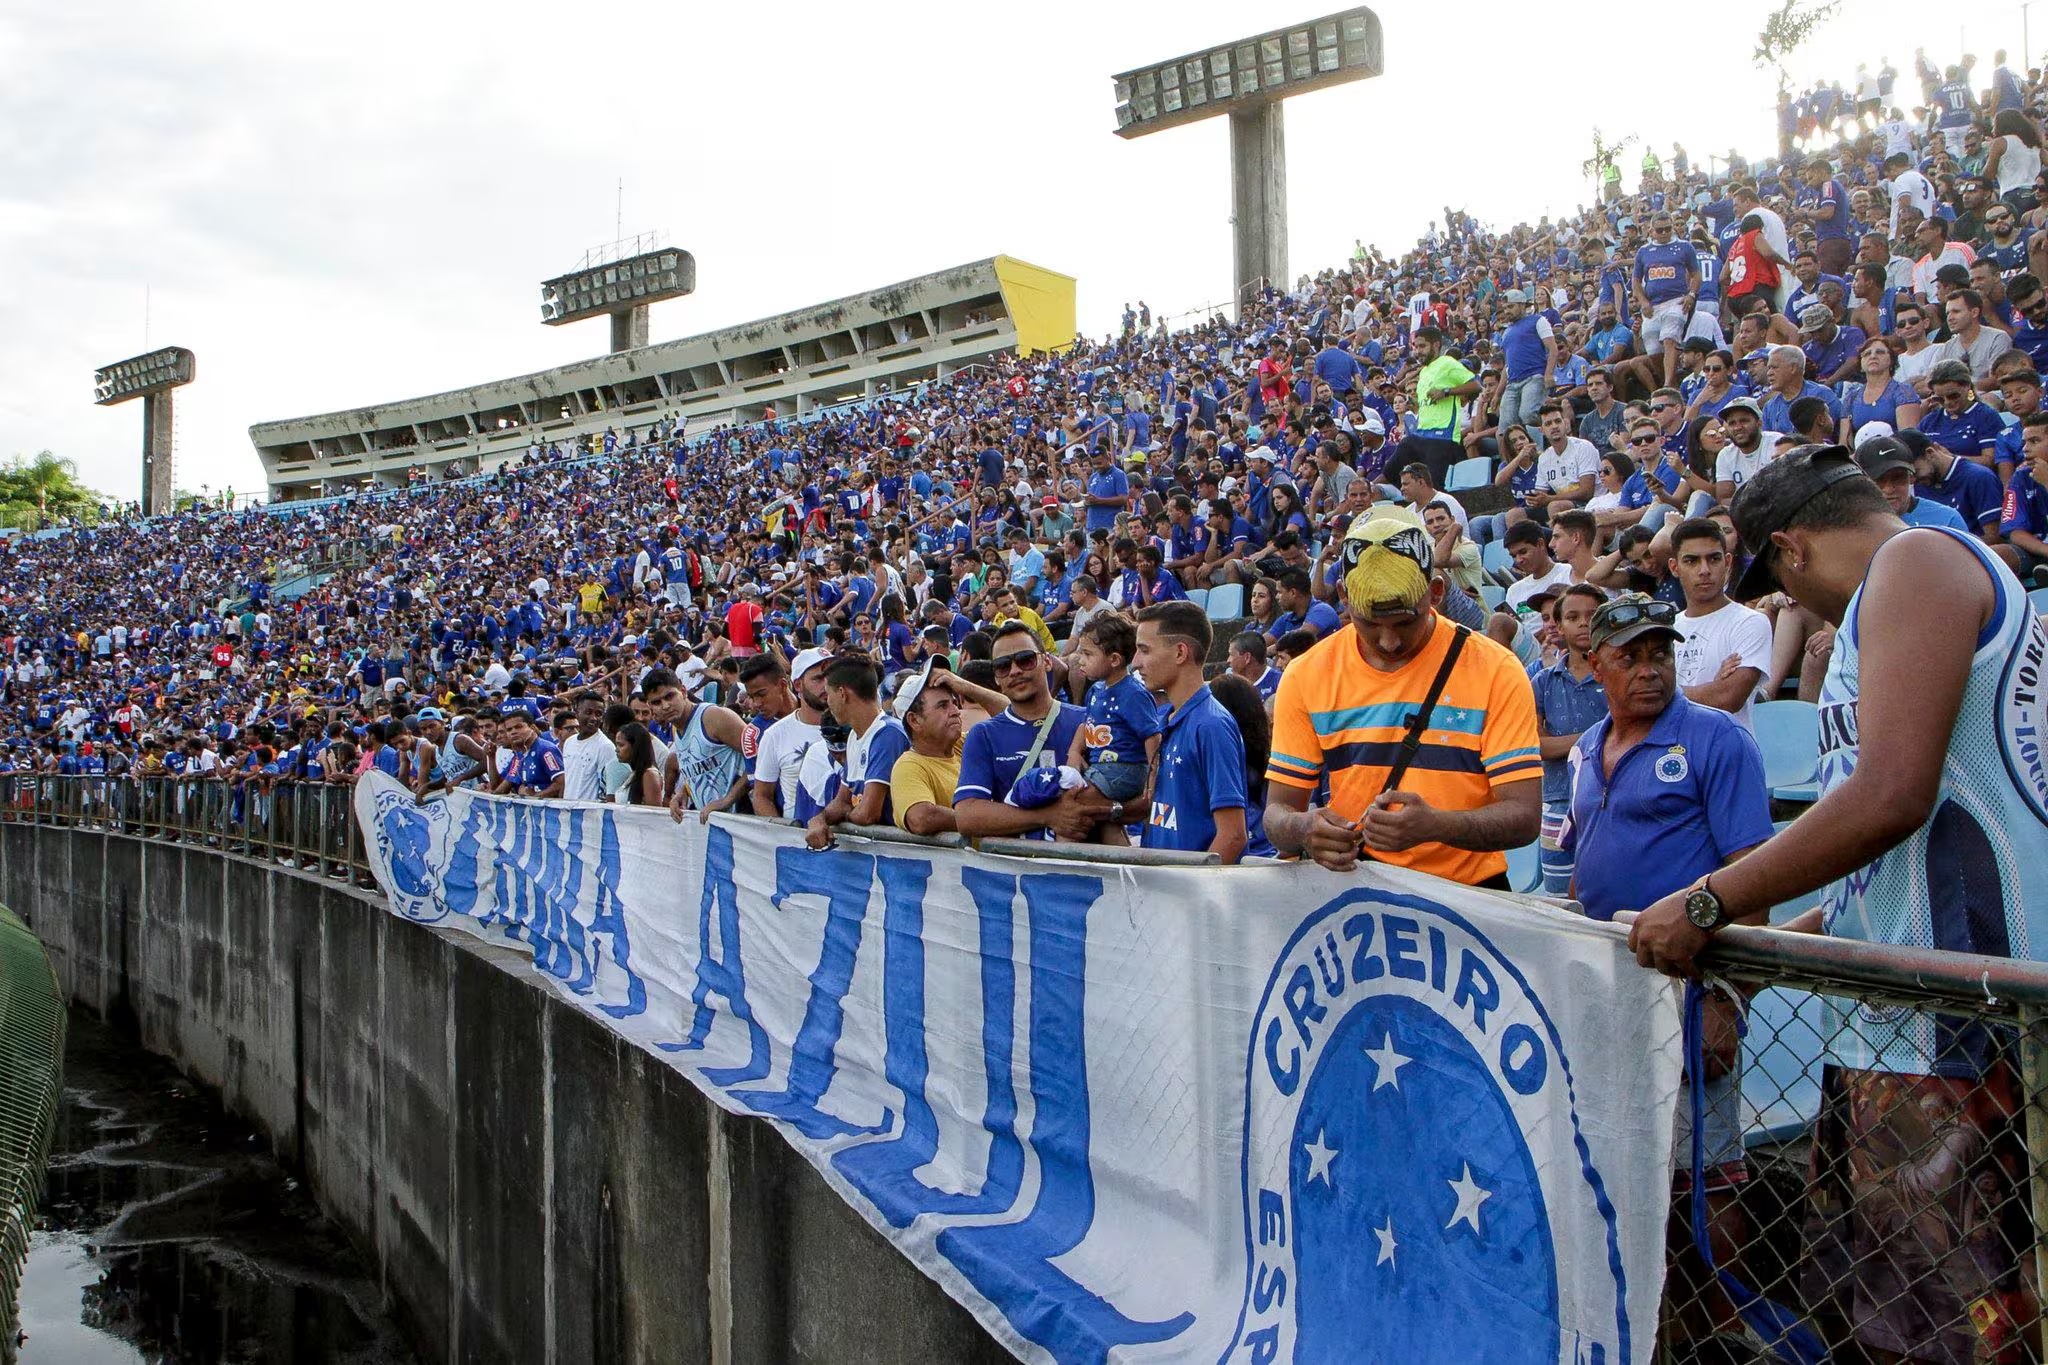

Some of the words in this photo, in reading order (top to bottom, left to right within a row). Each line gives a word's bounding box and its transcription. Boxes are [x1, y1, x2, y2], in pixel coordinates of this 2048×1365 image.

[1950, 92, 1965, 110] 10
[1547, 470, 1556, 481] 10
[217, 652, 230, 662] 55
[1264, 912, 1547, 1097] CRUZEIRO
[654, 824, 1196, 1365] AZUL
